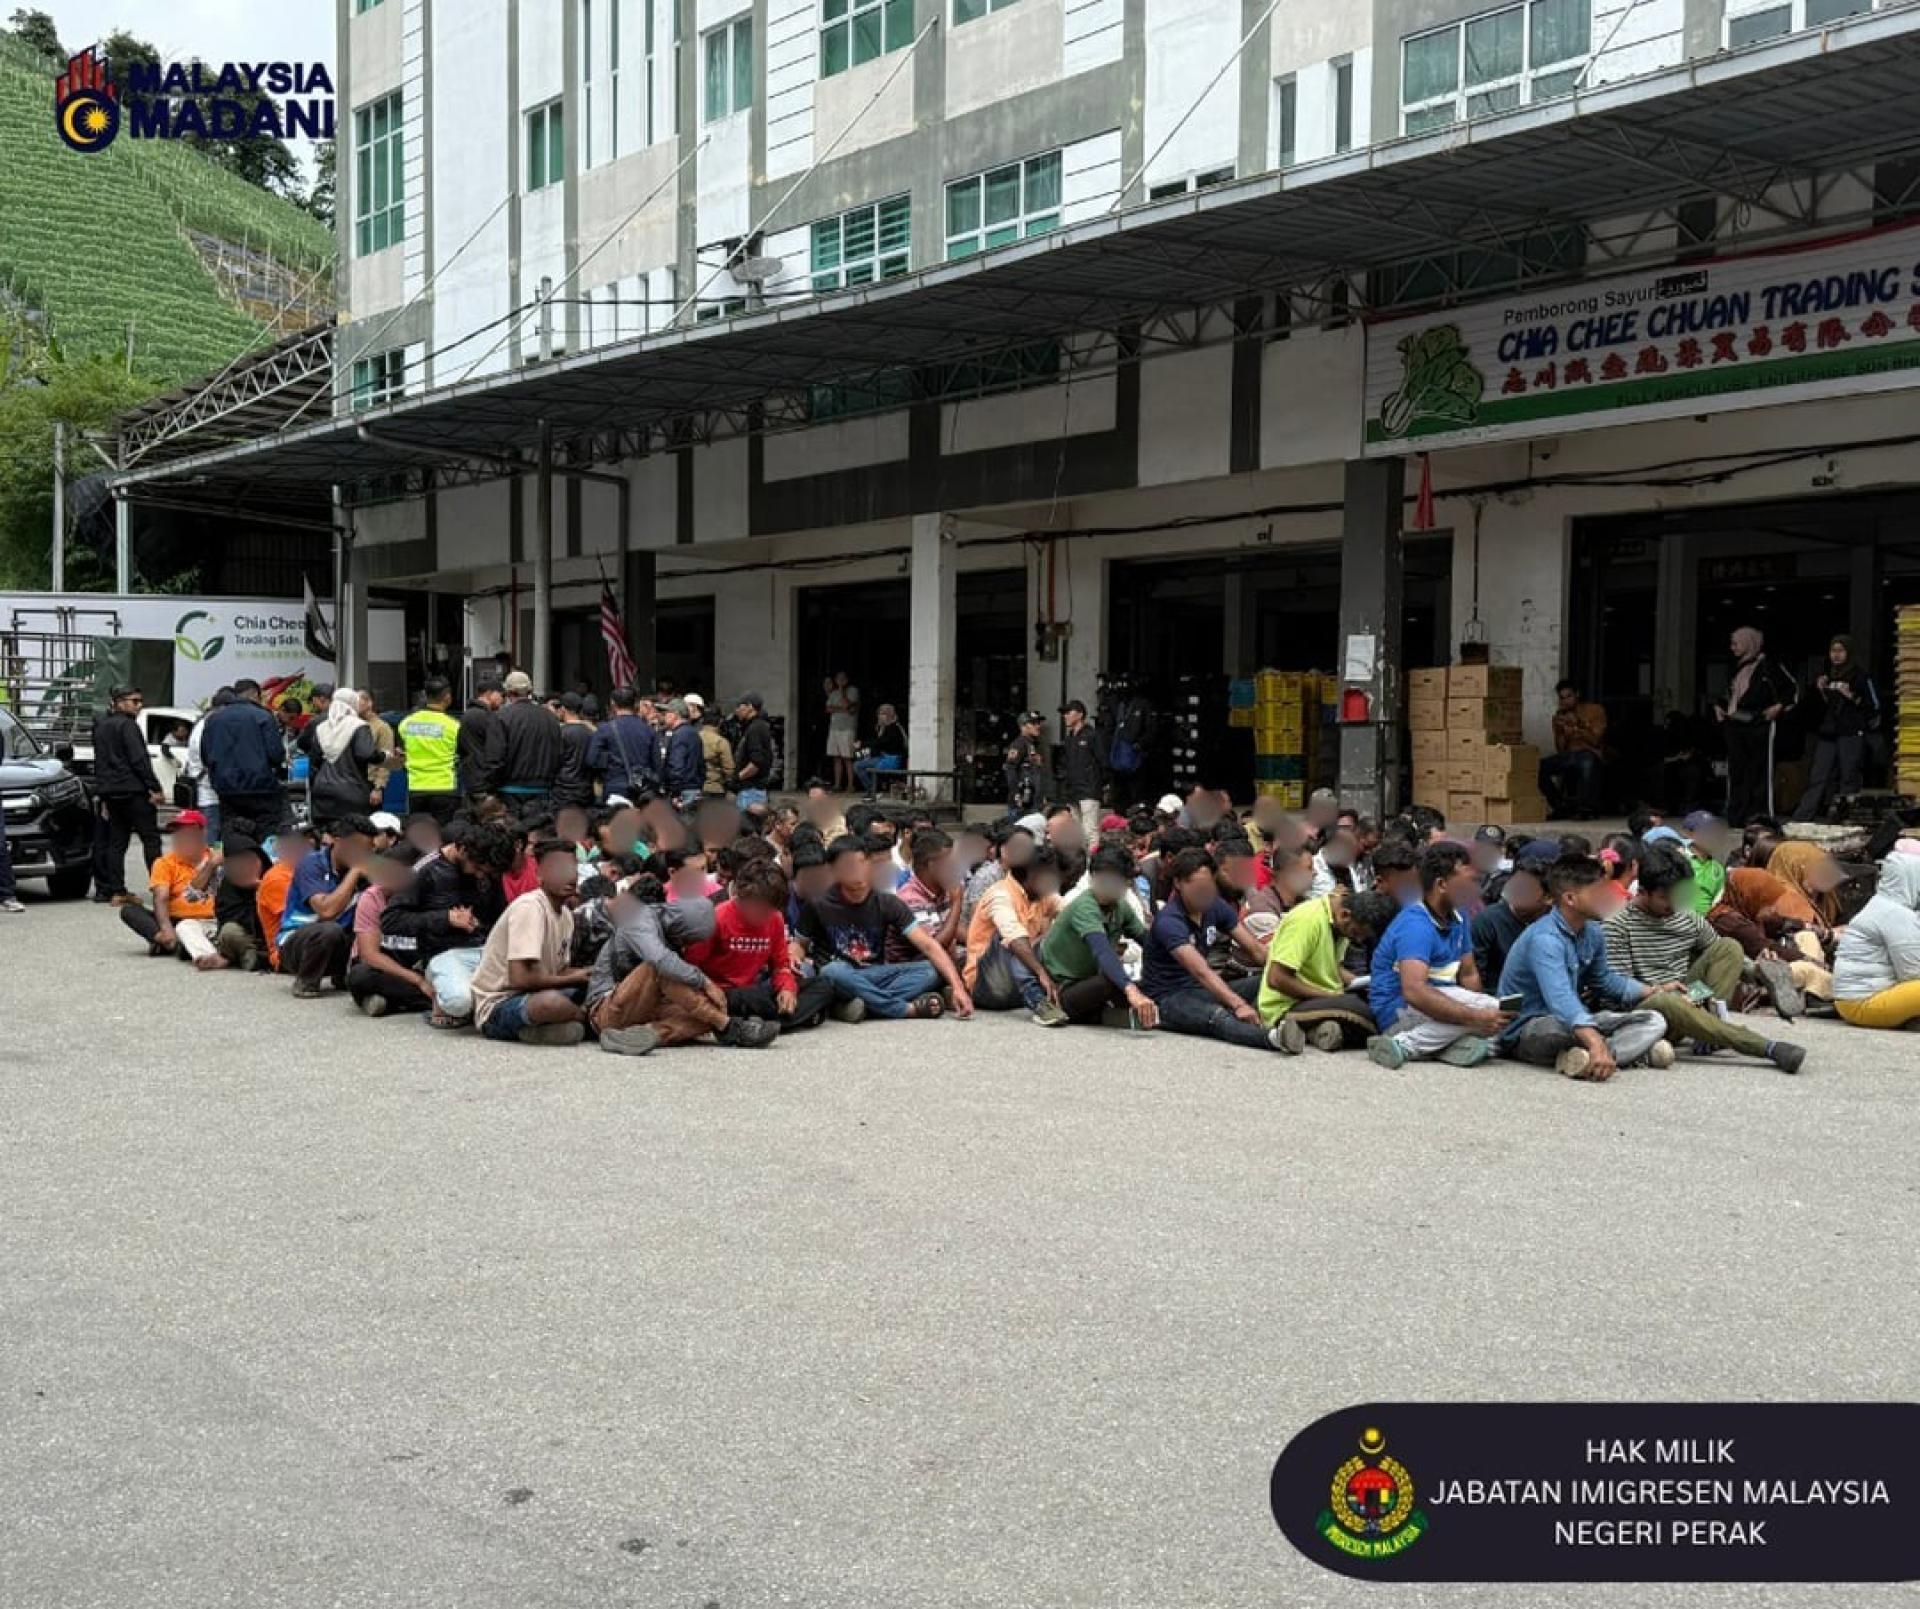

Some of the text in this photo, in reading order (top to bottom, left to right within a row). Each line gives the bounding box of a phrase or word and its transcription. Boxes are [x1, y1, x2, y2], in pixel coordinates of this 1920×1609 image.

[1498, 324, 1558, 363] CHIA
[1566, 310, 1640, 352] CHEE
[1647, 290, 1750, 338] CHUAN
[1760, 266, 1900, 320] TRADING
[1504, 286, 1656, 325] Pemborong Sayur
[234, 615, 267, 630] Chia
[235, 634, 276, 648] Trading
